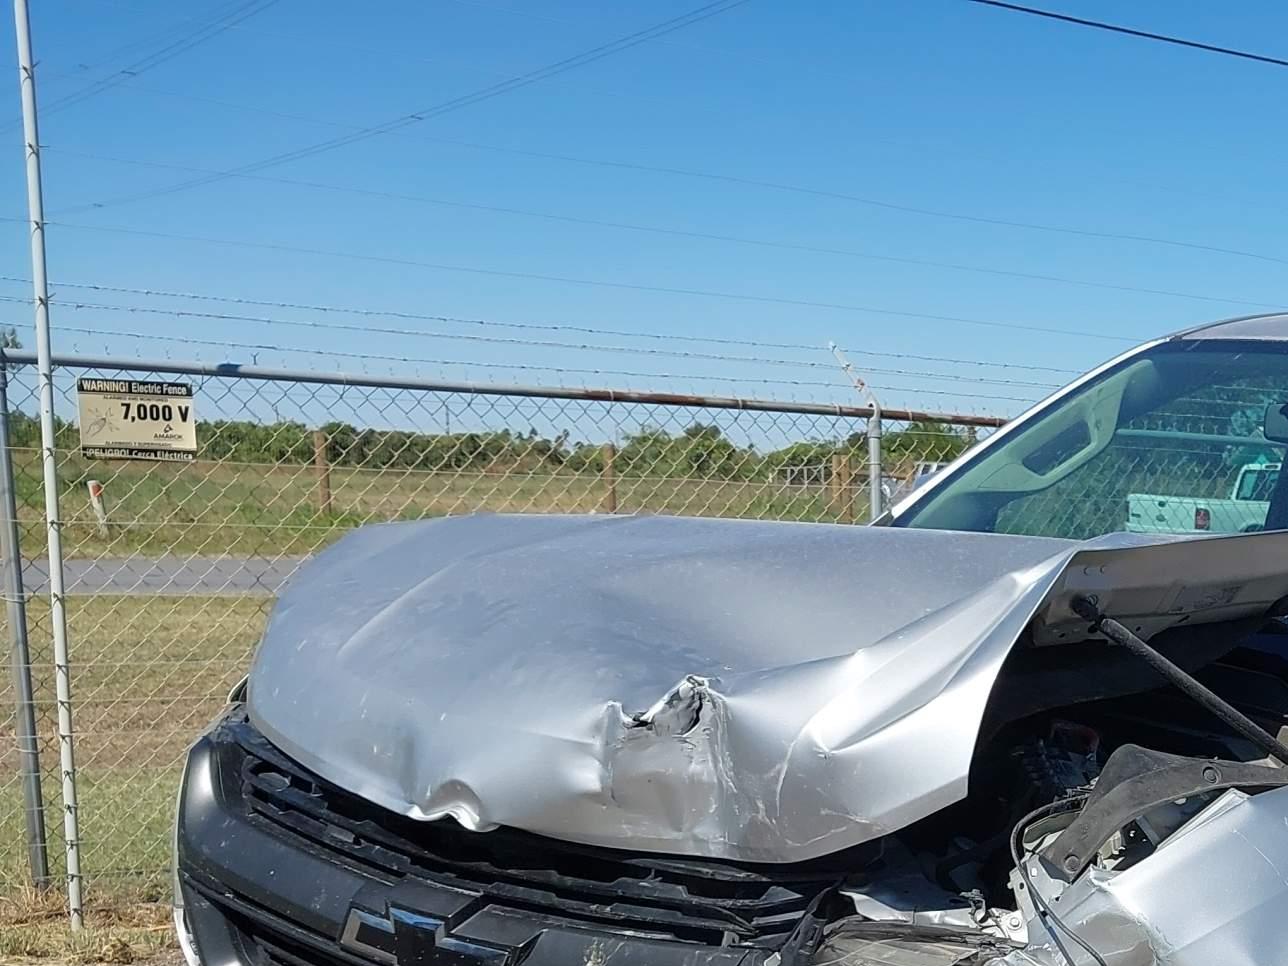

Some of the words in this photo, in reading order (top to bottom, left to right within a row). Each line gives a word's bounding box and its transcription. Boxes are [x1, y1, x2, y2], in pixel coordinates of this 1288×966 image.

[82, 380, 129, 393] WARNING!
[132, 382, 161, 394] Electric
[163, 385, 187, 395] Fence
[121, 402, 173, 422] 7,000
[178, 405, 189, 422] V
